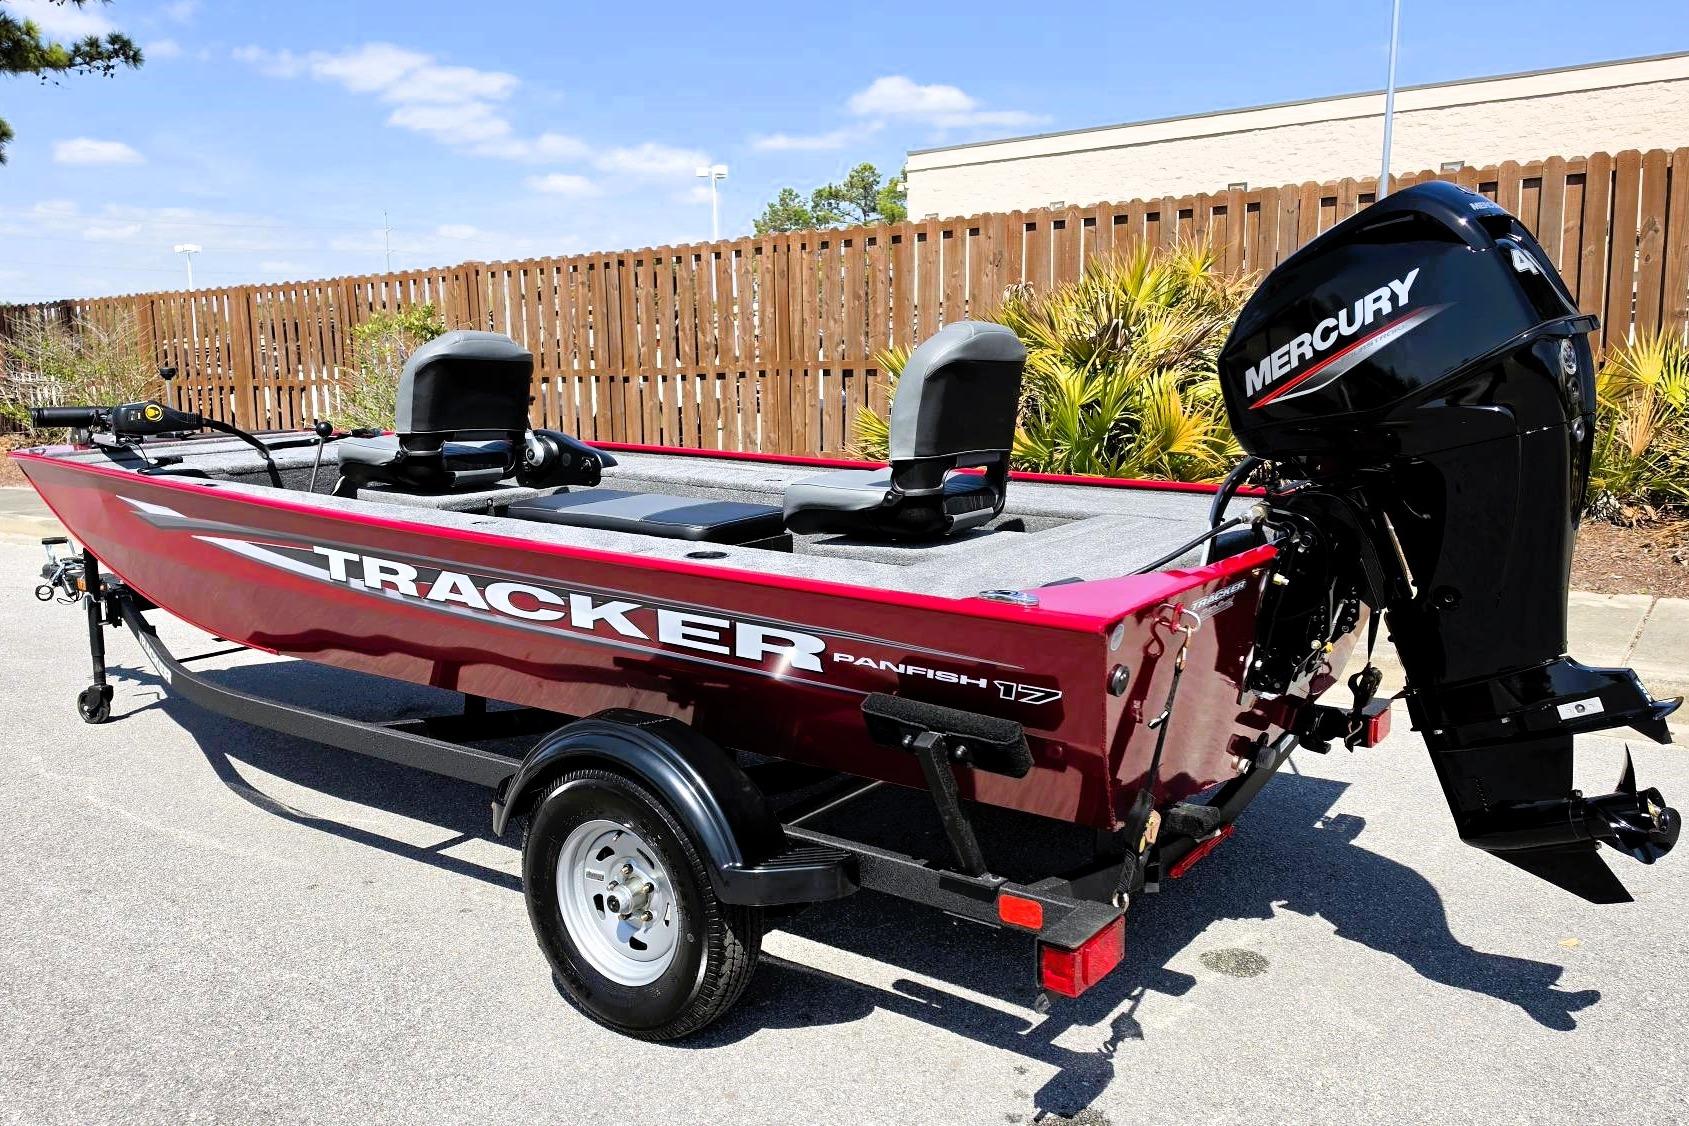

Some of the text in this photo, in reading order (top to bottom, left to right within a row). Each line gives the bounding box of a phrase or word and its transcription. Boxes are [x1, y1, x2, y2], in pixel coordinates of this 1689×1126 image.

[1245, 267, 1419, 397] MERCURY
[313, 545, 1063, 705] TRACKER PANFISH 17
[1191, 578, 1247, 610] TRACKER
